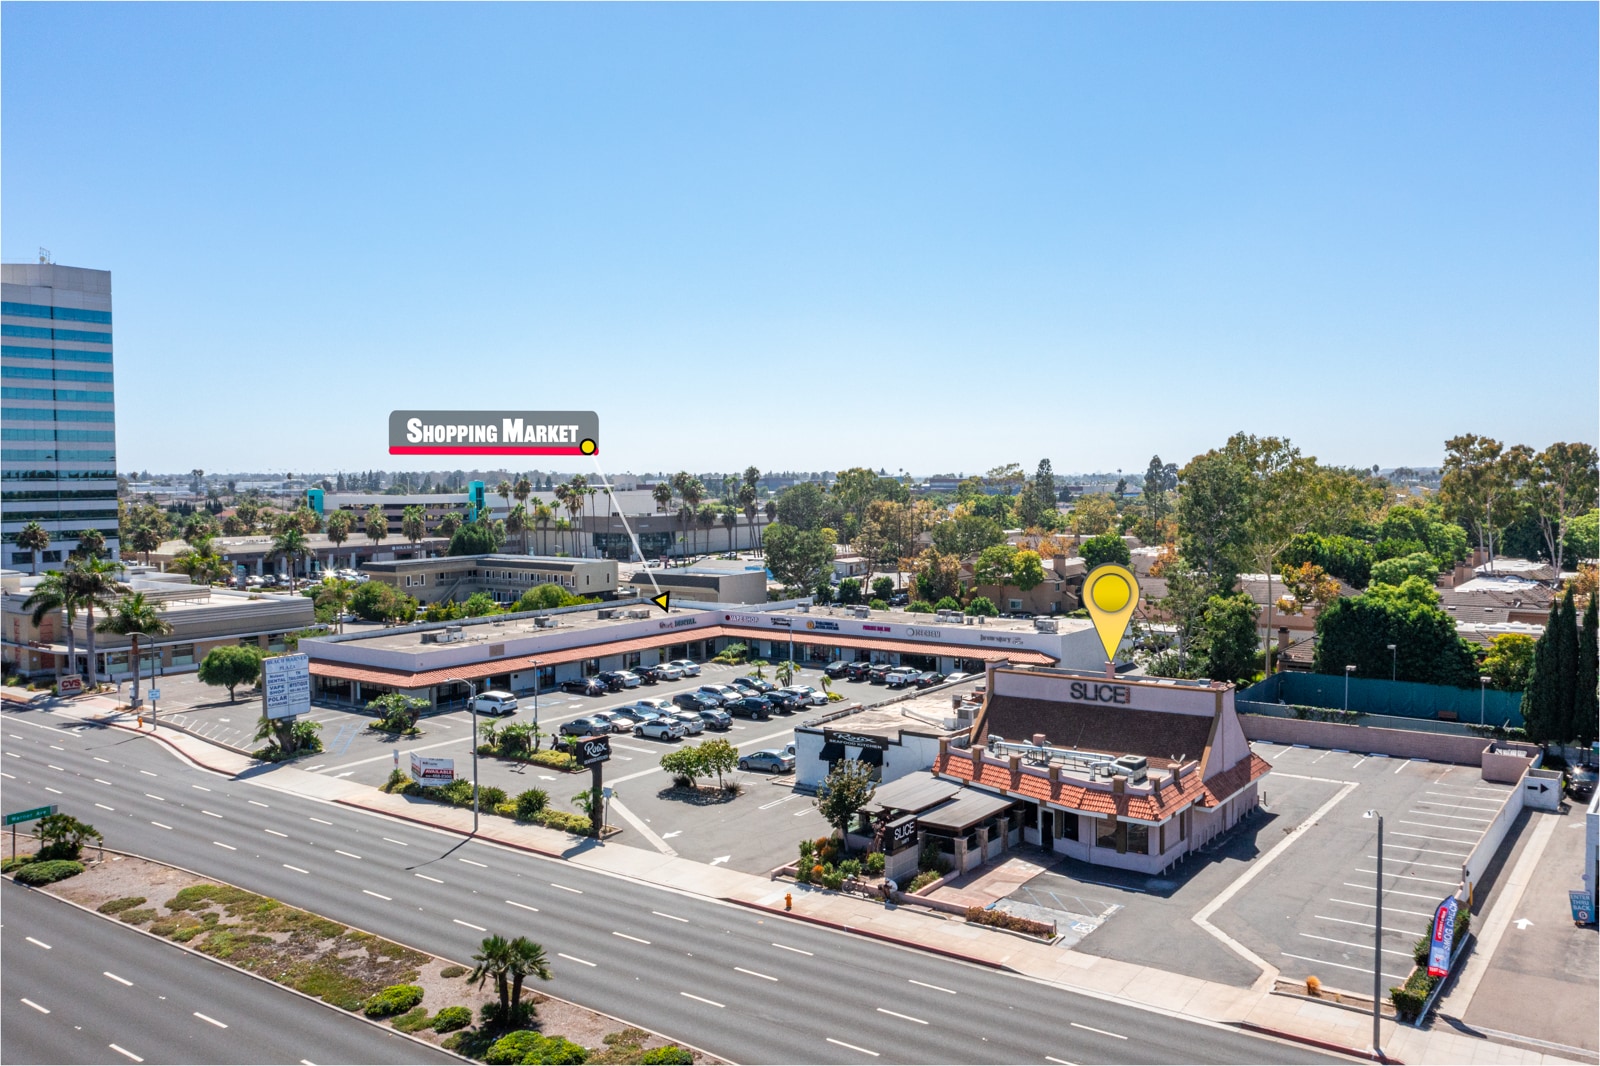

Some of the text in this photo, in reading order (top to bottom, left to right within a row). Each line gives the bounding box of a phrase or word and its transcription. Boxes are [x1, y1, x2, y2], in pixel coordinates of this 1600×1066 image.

[743, 616, 759, 624] SHOP
[61, 679, 81, 688] CVS
[1070, 682, 1126, 704] SLICE
[829, 738, 882, 749] SEAFOOD KITCHEN
[11, 813, 32, 821] Warner
[894, 821, 915, 841] SLICE
[1443, 900, 1458, 951] SMOG CHECK
